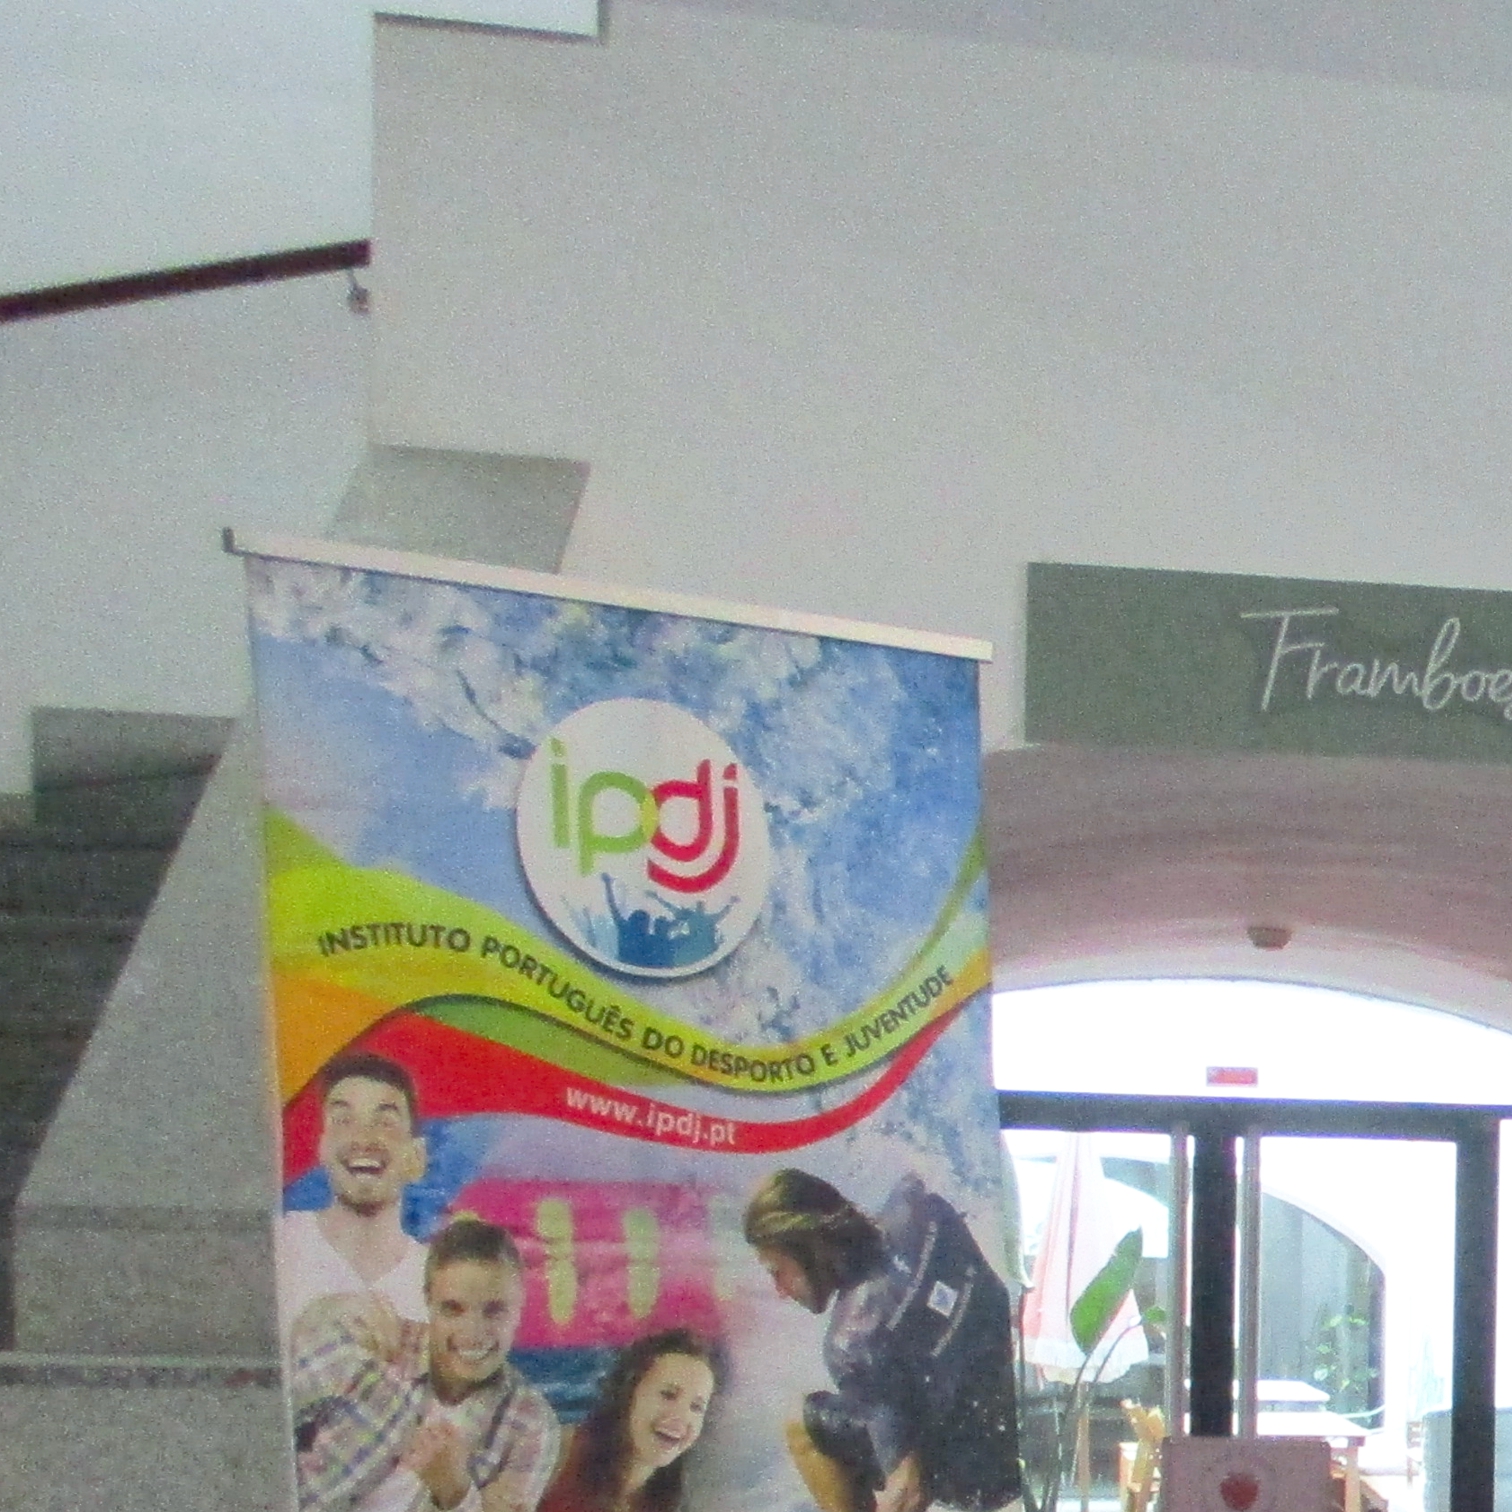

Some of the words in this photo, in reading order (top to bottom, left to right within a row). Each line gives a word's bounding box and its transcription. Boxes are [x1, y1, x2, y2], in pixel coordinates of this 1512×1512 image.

[550, 737, 740, 894] ipdj
[318, 921, 471, 958] INSTITUTO
[481, 934, 636, 1041] PORTUGUÊS
[641, 1026, 685, 1059] DO
[691, 1043, 816, 1085] DESPORTO
[819, 1042, 839, 1067] E
[844, 964, 955, 1059] JUVENTUDE
[566, 1085, 737, 1146] www.ipdj.pt
